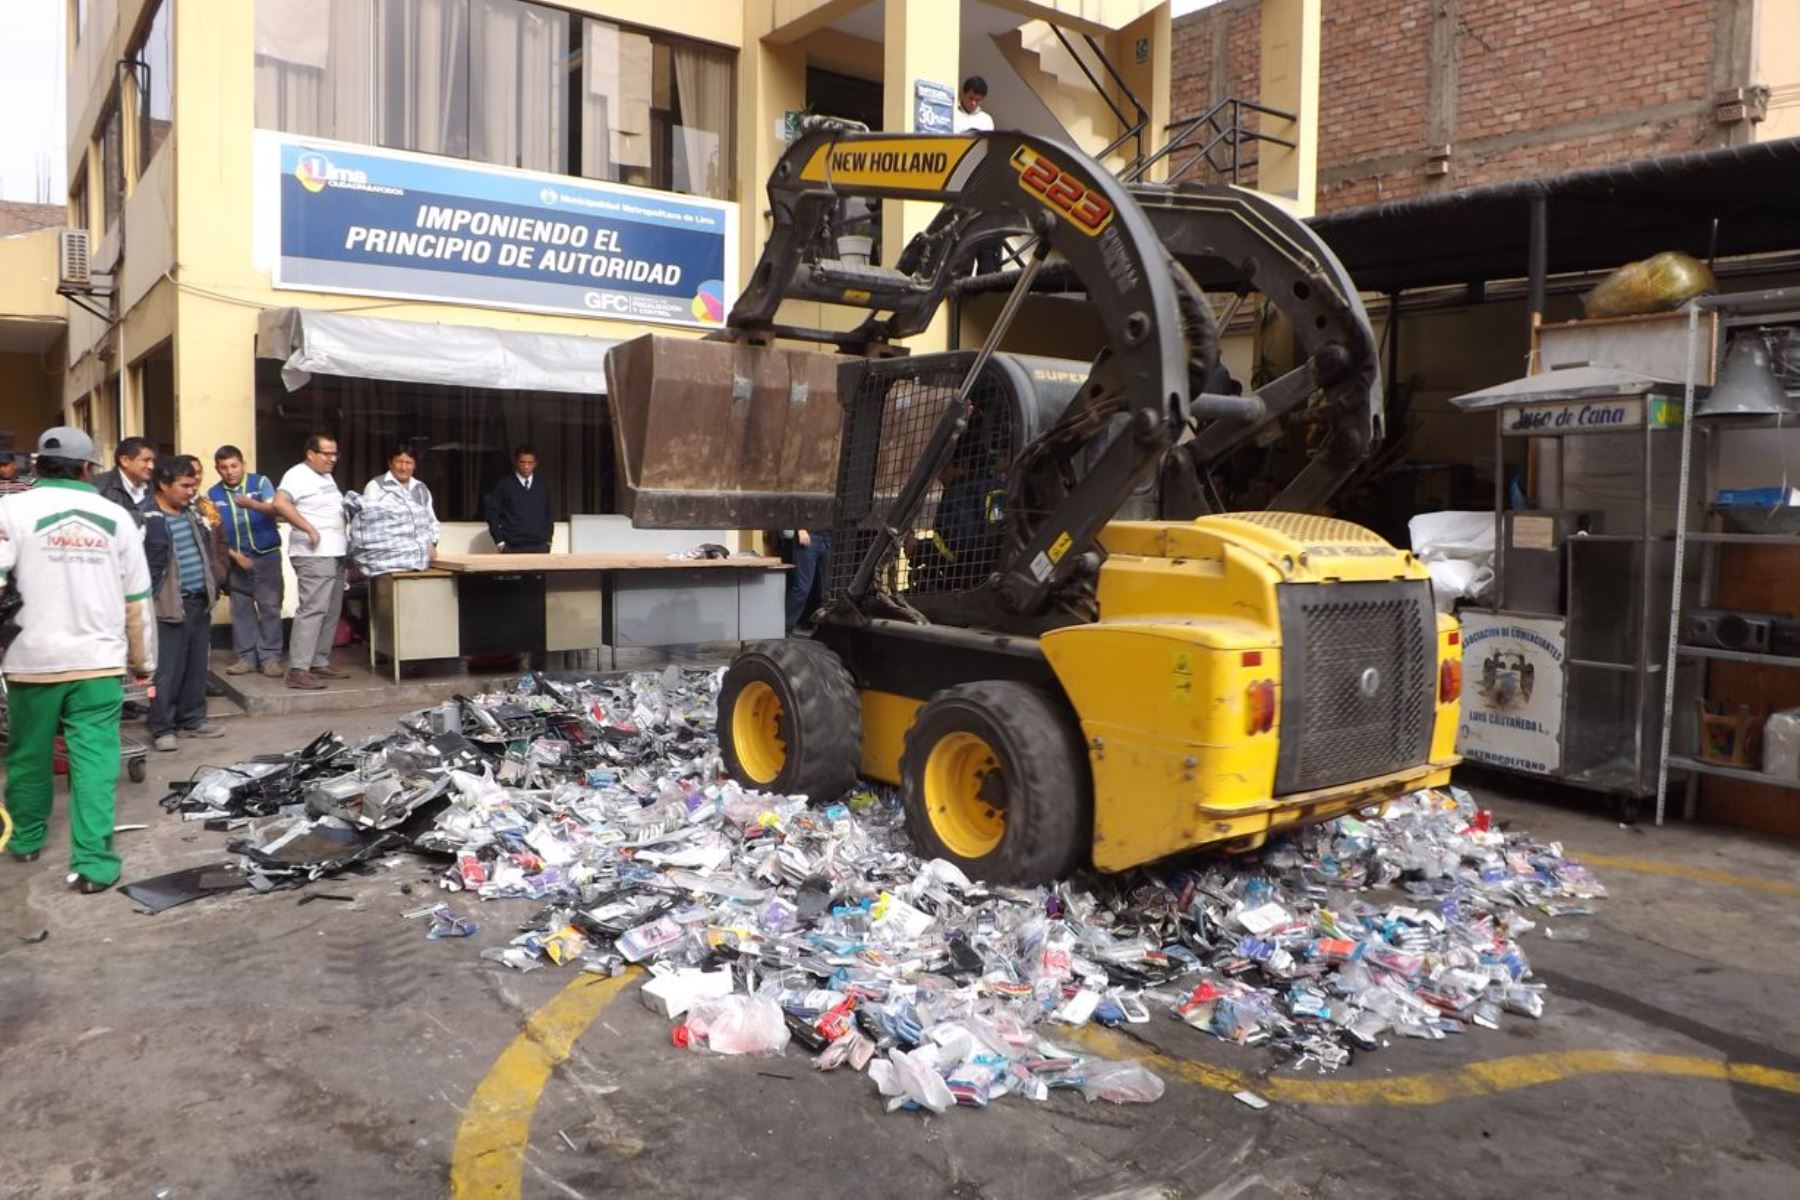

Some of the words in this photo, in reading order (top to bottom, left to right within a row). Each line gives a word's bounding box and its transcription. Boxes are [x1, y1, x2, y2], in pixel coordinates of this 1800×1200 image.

[832, 151, 868, 172] NEW
[870, 151, 948, 173] HOLLAND
[560, 193, 621, 212] Municipalidad
[622, 203, 682, 221] Metropolitana
[683, 213, 694, 222] de
[695, 215, 716, 225] Lima
[416, 205, 589, 248] IMPONIENDO
[594, 229, 621, 253] EL
[345, 226, 492, 264] PRINCIPIO
[498, 243, 535, 269] DE
[538, 249, 682, 286] AUTORIDAD
[584, 291, 629, 312] GFC
[1555, 406, 1572, 425] de
[1469, 710, 1487, 723] LUIS
[1489, 713, 1537, 732] CASTAÑEDA
[1466, 748, 1546, 771] METROPOLITANO
